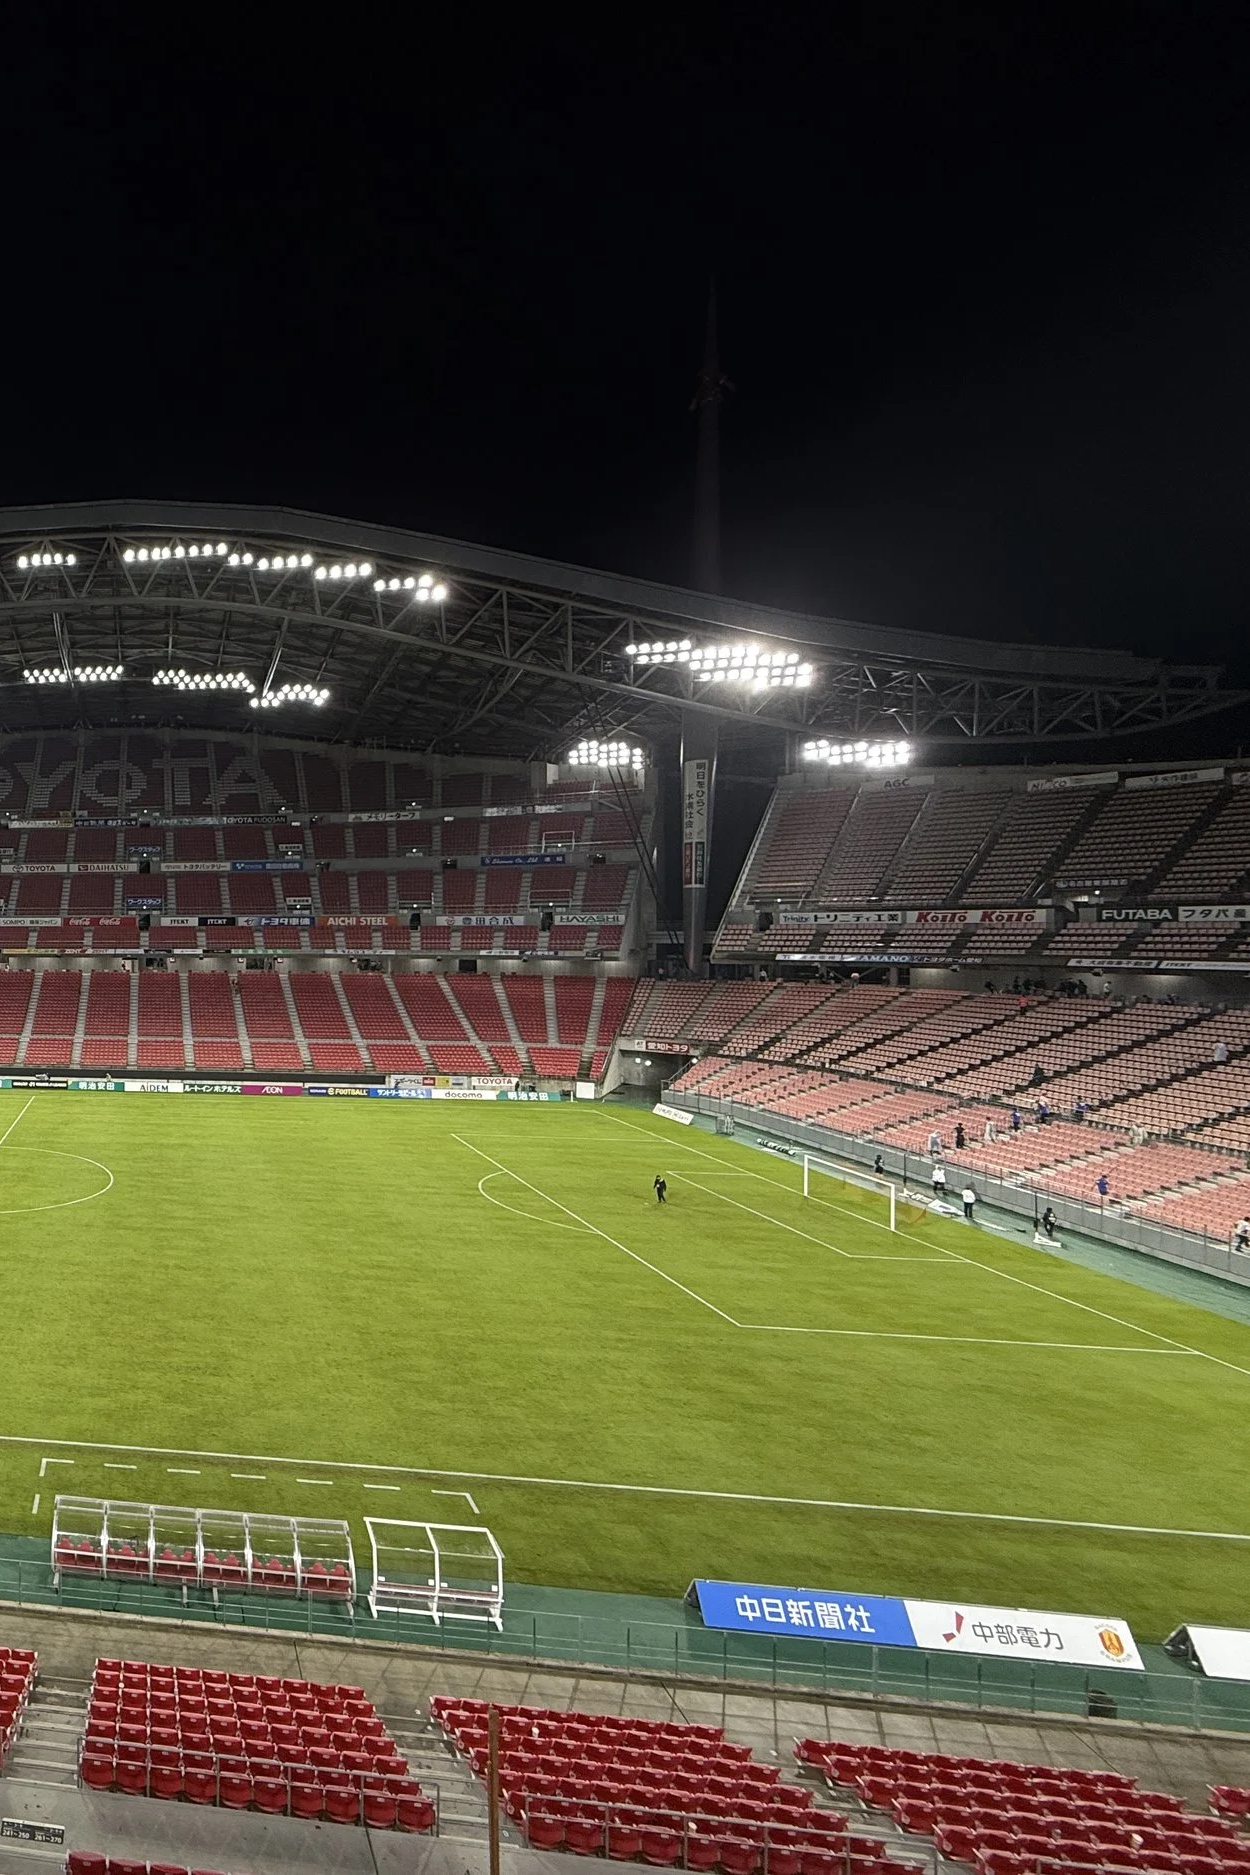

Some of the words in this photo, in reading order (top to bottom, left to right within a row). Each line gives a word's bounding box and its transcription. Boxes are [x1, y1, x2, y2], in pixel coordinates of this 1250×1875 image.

[883, 780, 910, 788] AGC
[223, 817, 252, 825] TOYOTA
[89, 865, 130, 873] DAIHATSU
[559, 915, 620, 923] HAYASHI
[814, 913, 899, 922] トリニティ工業
[1101, 909, 1173, 921] FUTABA
[260, 918, 310, 926] トヨタ車体
[327, 918, 356, 926] AICHI
[360, 918, 388, 926] STEEL
[862, 954, 909, 962] AMANO
[646, 1042, 689, 1052] 愛知トヨタ
[476, 1077, 513, 1085] TOYOTA
[78, 1081, 115, 1090] 明治安田
[445, 1090, 483, 1098] docomo
[507, 1090, 549, 1101] 明治安田
[734, 1594, 876, 1633] 中日新聞社
[970, 1621, 1065, 1651] 中部電力
